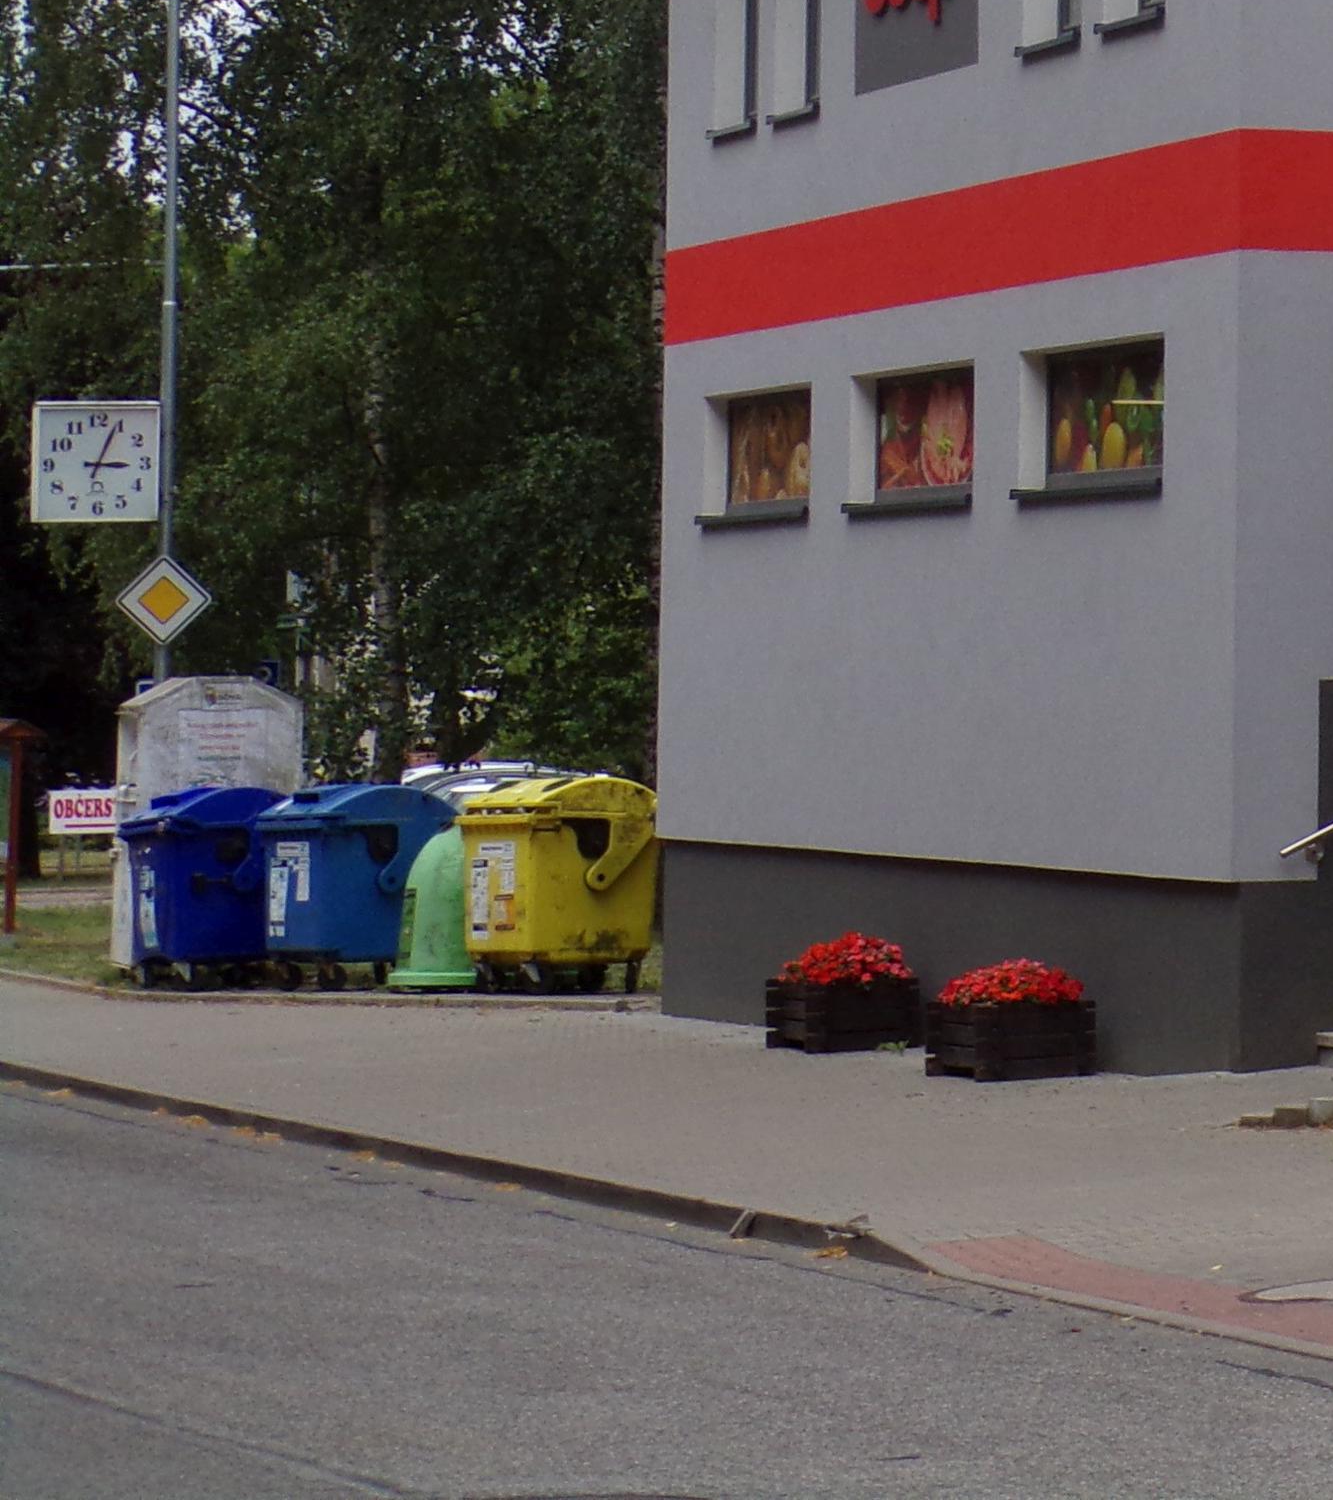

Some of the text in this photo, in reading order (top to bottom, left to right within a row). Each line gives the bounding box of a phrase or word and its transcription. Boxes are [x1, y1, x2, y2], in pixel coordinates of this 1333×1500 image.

[67, 420, 82, 435] 11
[89, 412, 108, 428] 12
[116, 419, 124, 433] 1
[51, 437, 72, 452] 10
[131, 433, 144, 448] 2
[43, 458, 55, 473] 9
[140, 456, 151, 470] 3
[50, 480, 64, 495] 8
[131, 477, 142, 492] 4
[67, 495, 79, 511] 7
[92, 500, 104, 515] 6
[115, 494, 127, 509] 5
[54, 793, 115, 818] OBČERS
